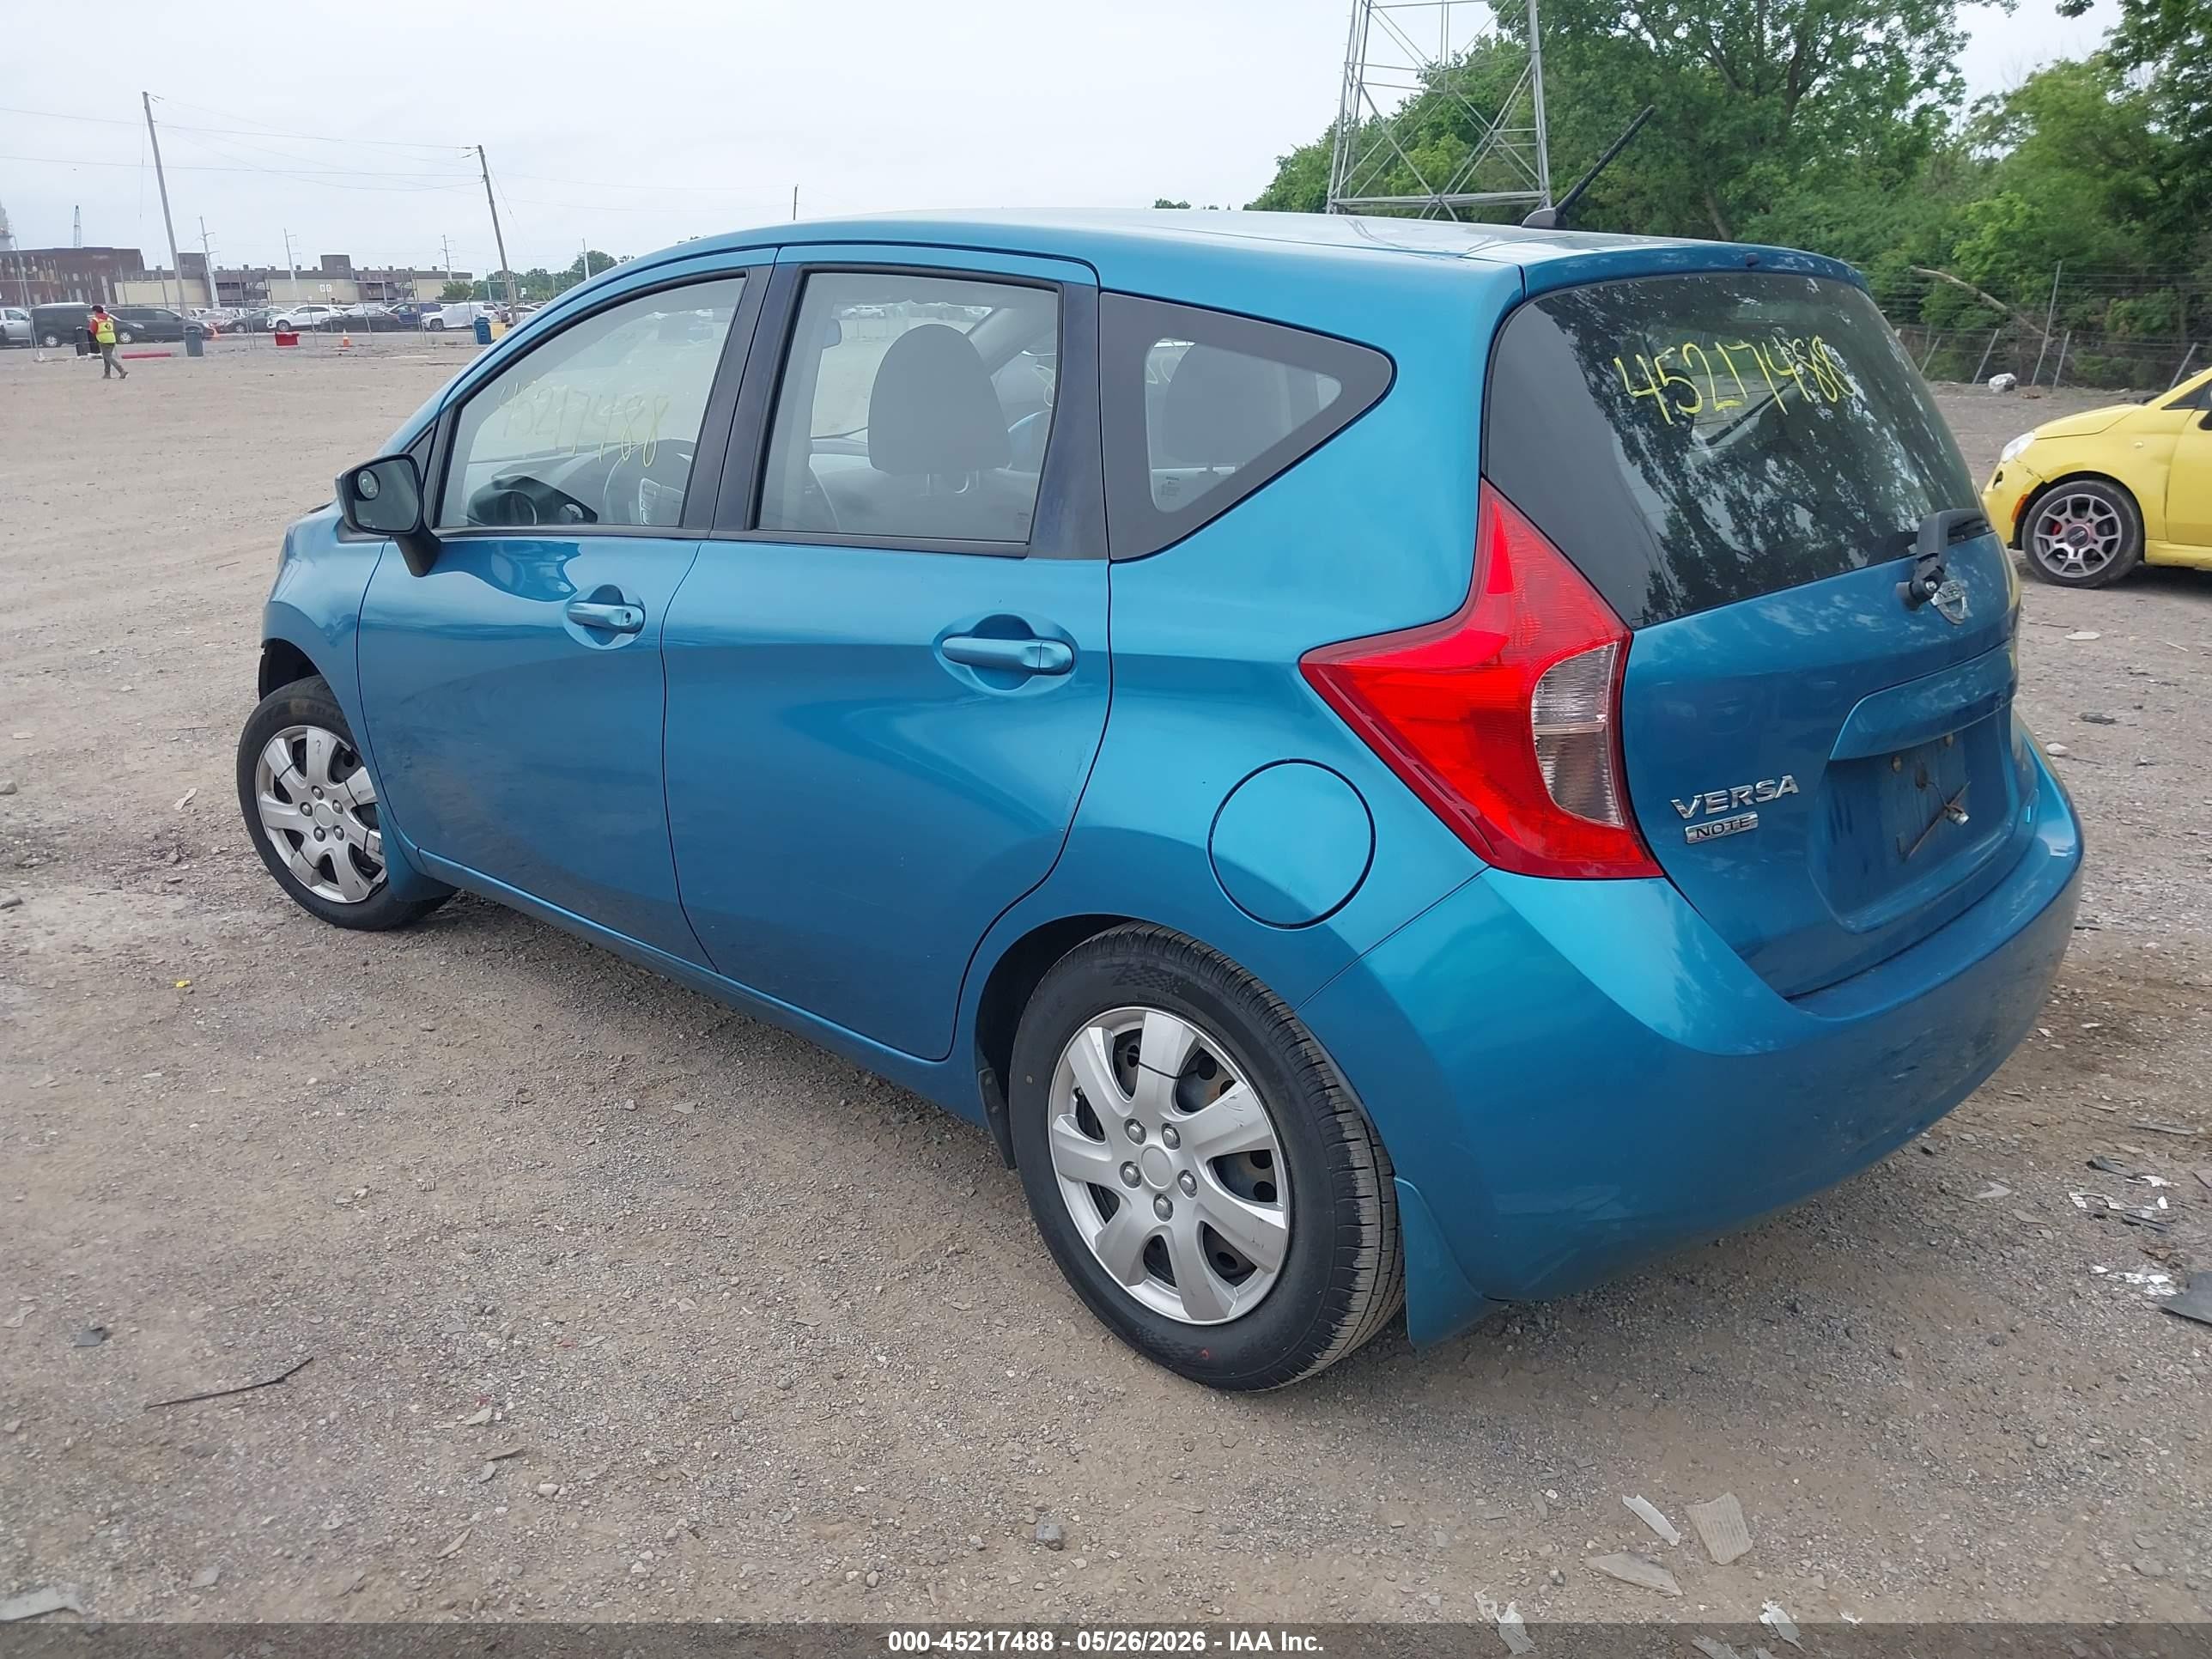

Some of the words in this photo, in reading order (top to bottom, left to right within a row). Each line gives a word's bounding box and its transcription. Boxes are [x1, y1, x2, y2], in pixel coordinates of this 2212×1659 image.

[1613, 334, 1856, 426] 45217488
[1669, 774, 1801, 820] VERSA
[1694, 815, 1752, 840] NOTE
